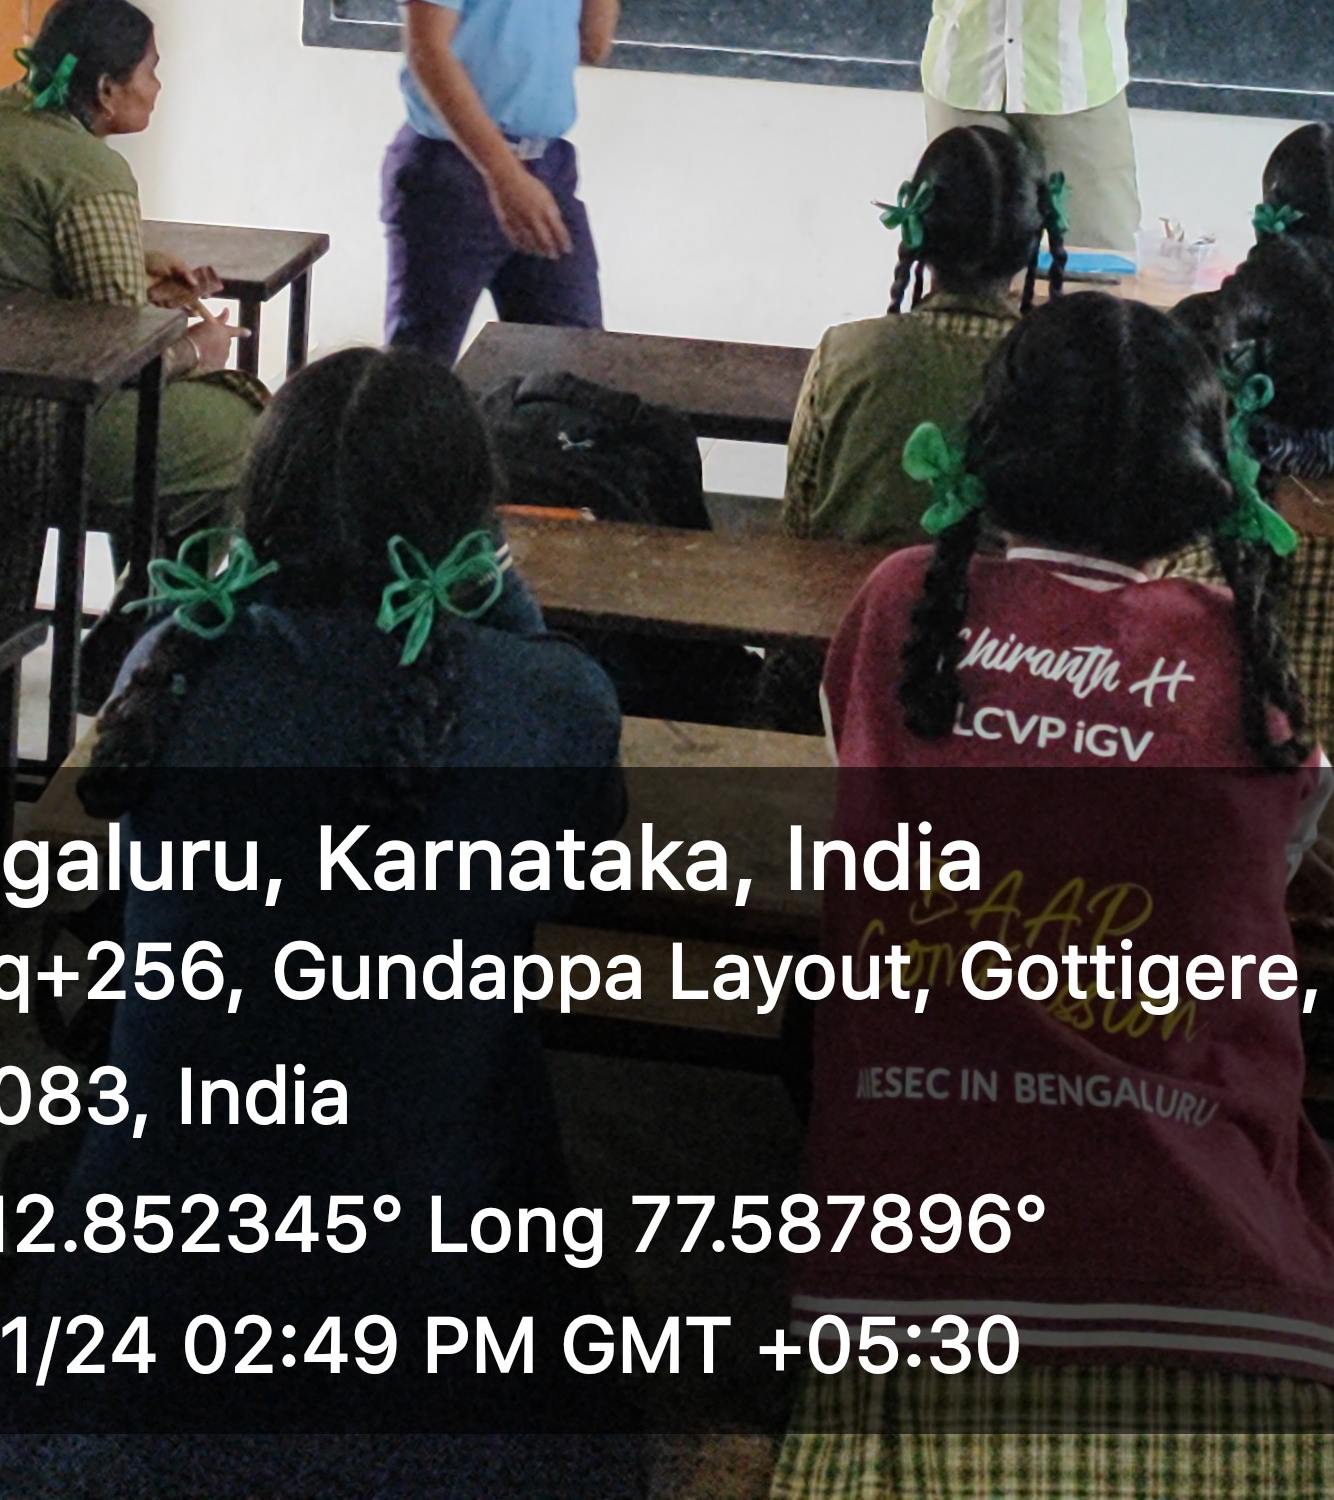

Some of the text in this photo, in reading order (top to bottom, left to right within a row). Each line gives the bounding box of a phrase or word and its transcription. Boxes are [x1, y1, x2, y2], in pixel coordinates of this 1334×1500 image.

[956, 626, 1196, 708] hiranth H
[1073, 720, 1155, 763] iGV
[960, 1067, 998, 1103] IN
[1014, 1071, 1221, 1129] BENGALURU
